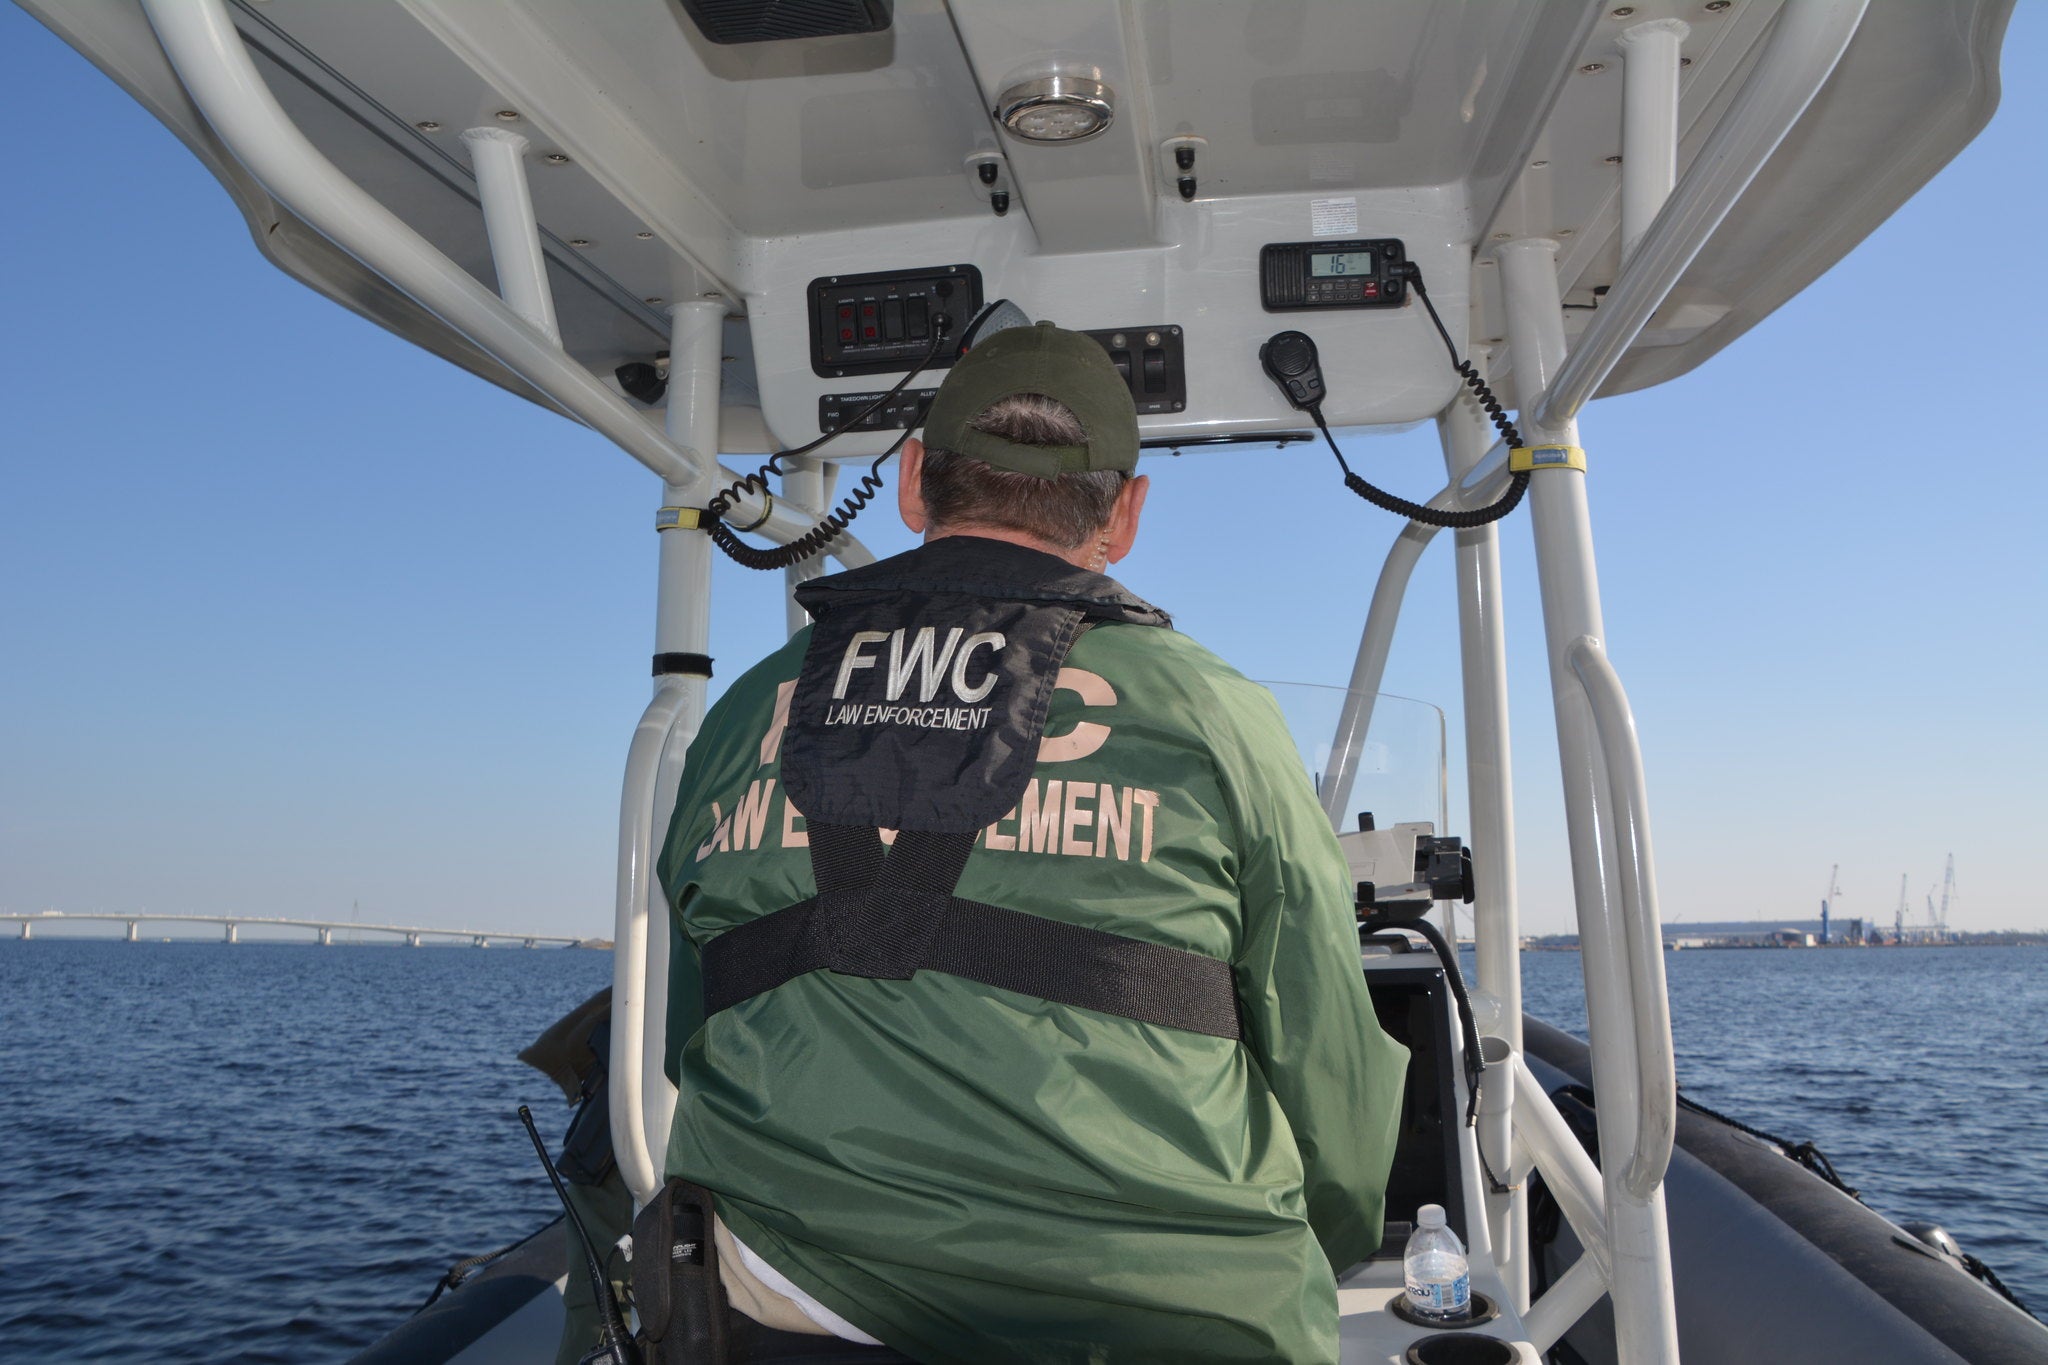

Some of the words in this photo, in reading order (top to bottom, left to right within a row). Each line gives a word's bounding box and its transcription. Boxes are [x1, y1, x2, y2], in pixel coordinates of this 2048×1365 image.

[1330, 254, 1346, 274] 16
[832, 627, 1006, 703] FWC
[825, 705, 862, 725] LAW
[864, 706, 992, 730] ENFORCEMENT
